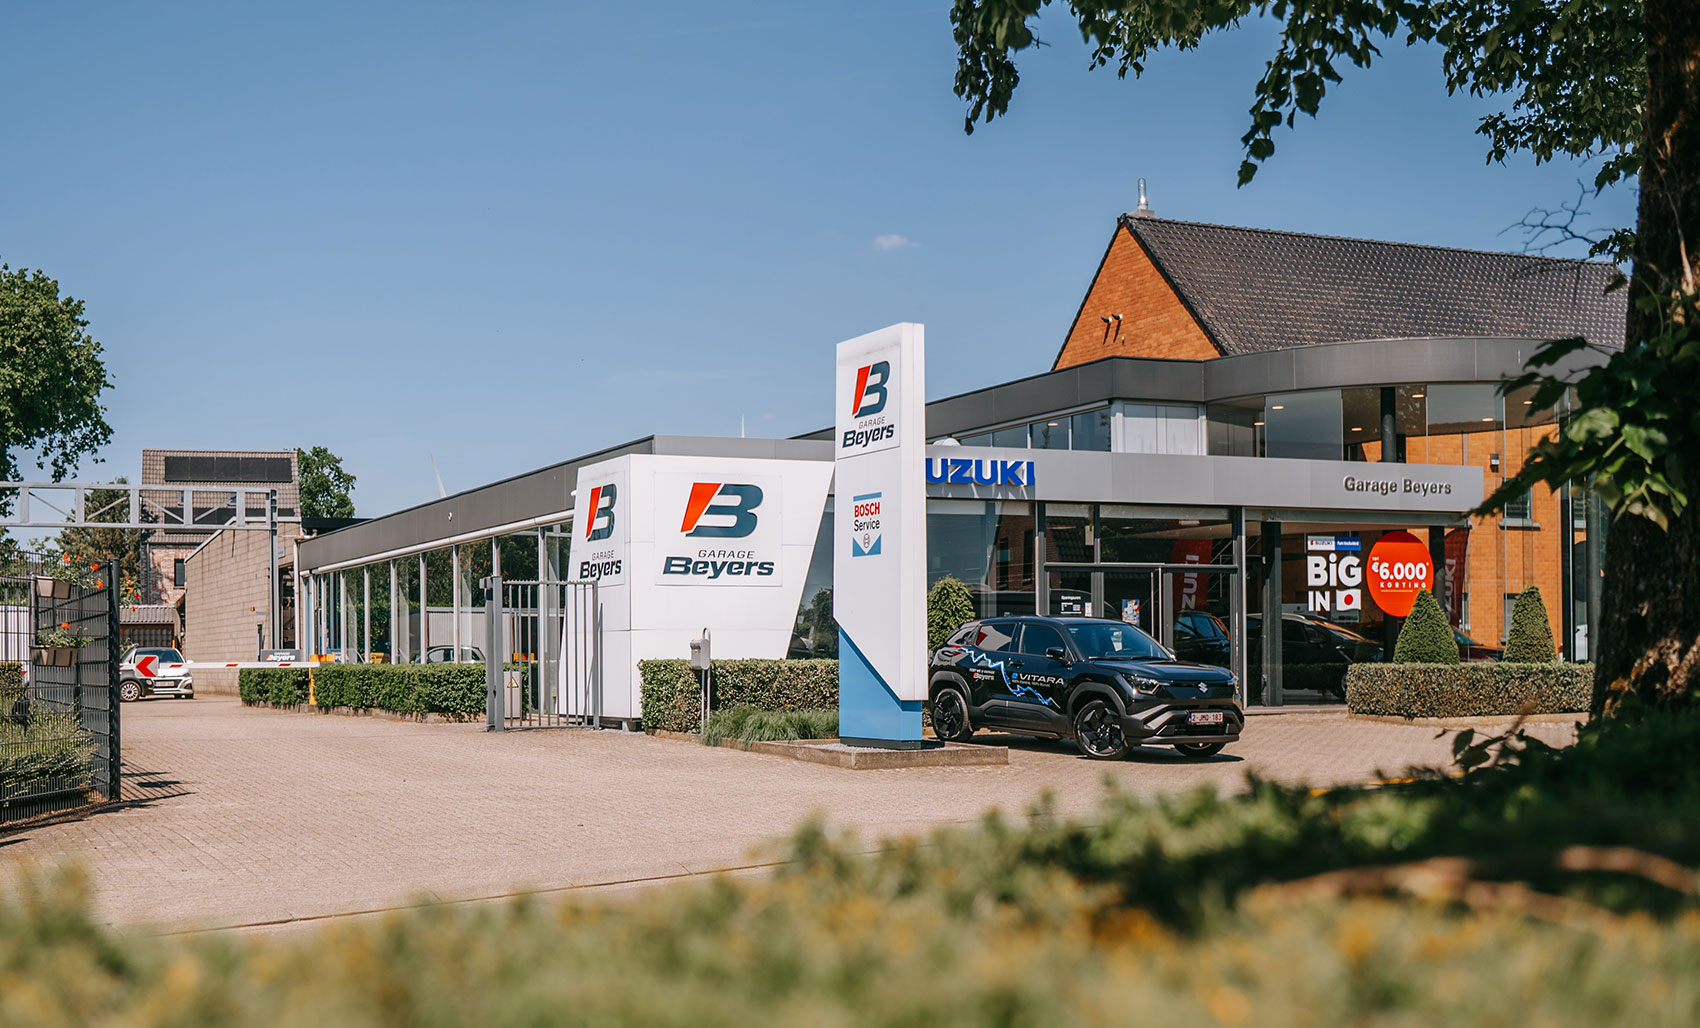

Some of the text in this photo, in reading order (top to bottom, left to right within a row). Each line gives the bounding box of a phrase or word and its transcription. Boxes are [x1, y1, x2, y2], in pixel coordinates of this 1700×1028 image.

[858, 416, 886, 429] GARAGE
[842, 423, 895, 448] Beyers
[926, 457, 1036, 486] UZUKI
[1343, 475, 1452, 496] Garage Beyers
[854, 502, 881, 518] BOSCH
[854, 518, 881, 532] Service
[591, 550, 615, 560] GARAGE
[698, 549, 755, 559] GARAGE
[579, 559, 622, 581] Beyers
[663, 556, 775, 579] Beyers
[1308, 591, 1330, 611] IN
[1020, 673, 1064, 685] VITARA
